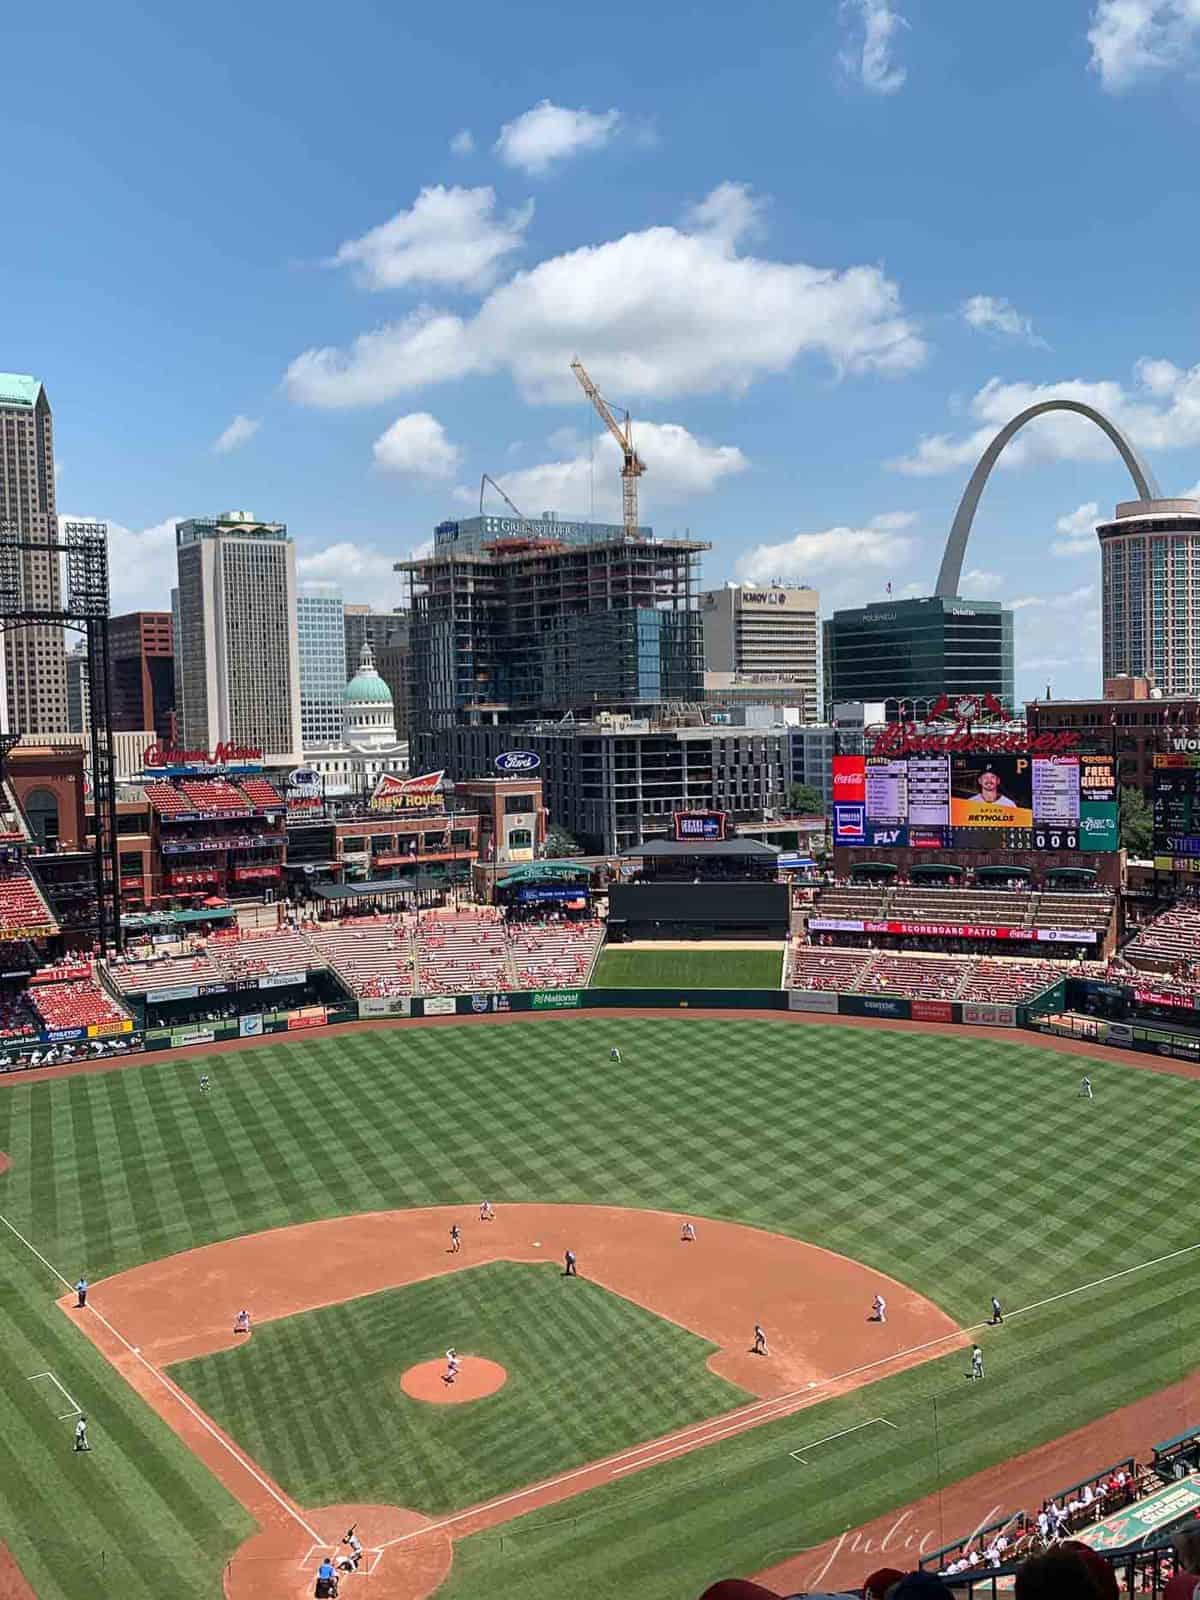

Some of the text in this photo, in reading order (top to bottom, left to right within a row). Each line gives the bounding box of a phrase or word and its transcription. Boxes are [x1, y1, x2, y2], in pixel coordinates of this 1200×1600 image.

[864, 720, 1082, 756] Budweiser
[144, 739, 263, 768] Cardinals Nation
[504, 753, 532, 768] Ford
[1084, 766, 1111, 777] FREE
[834, 773, 863, 784] Coca-Cola
[1080, 776, 1116, 788] QUESO
[370, 793, 444, 808] BREW HOUSE
[968, 814, 1015, 822] REYNOLDS
[873, 830, 900, 844] FLY
[1036, 835, 1076, 848] 0 0 0
[901, 924, 998, 938] SCOREBOARD PATIO
[542, 992, 578, 1003] National
